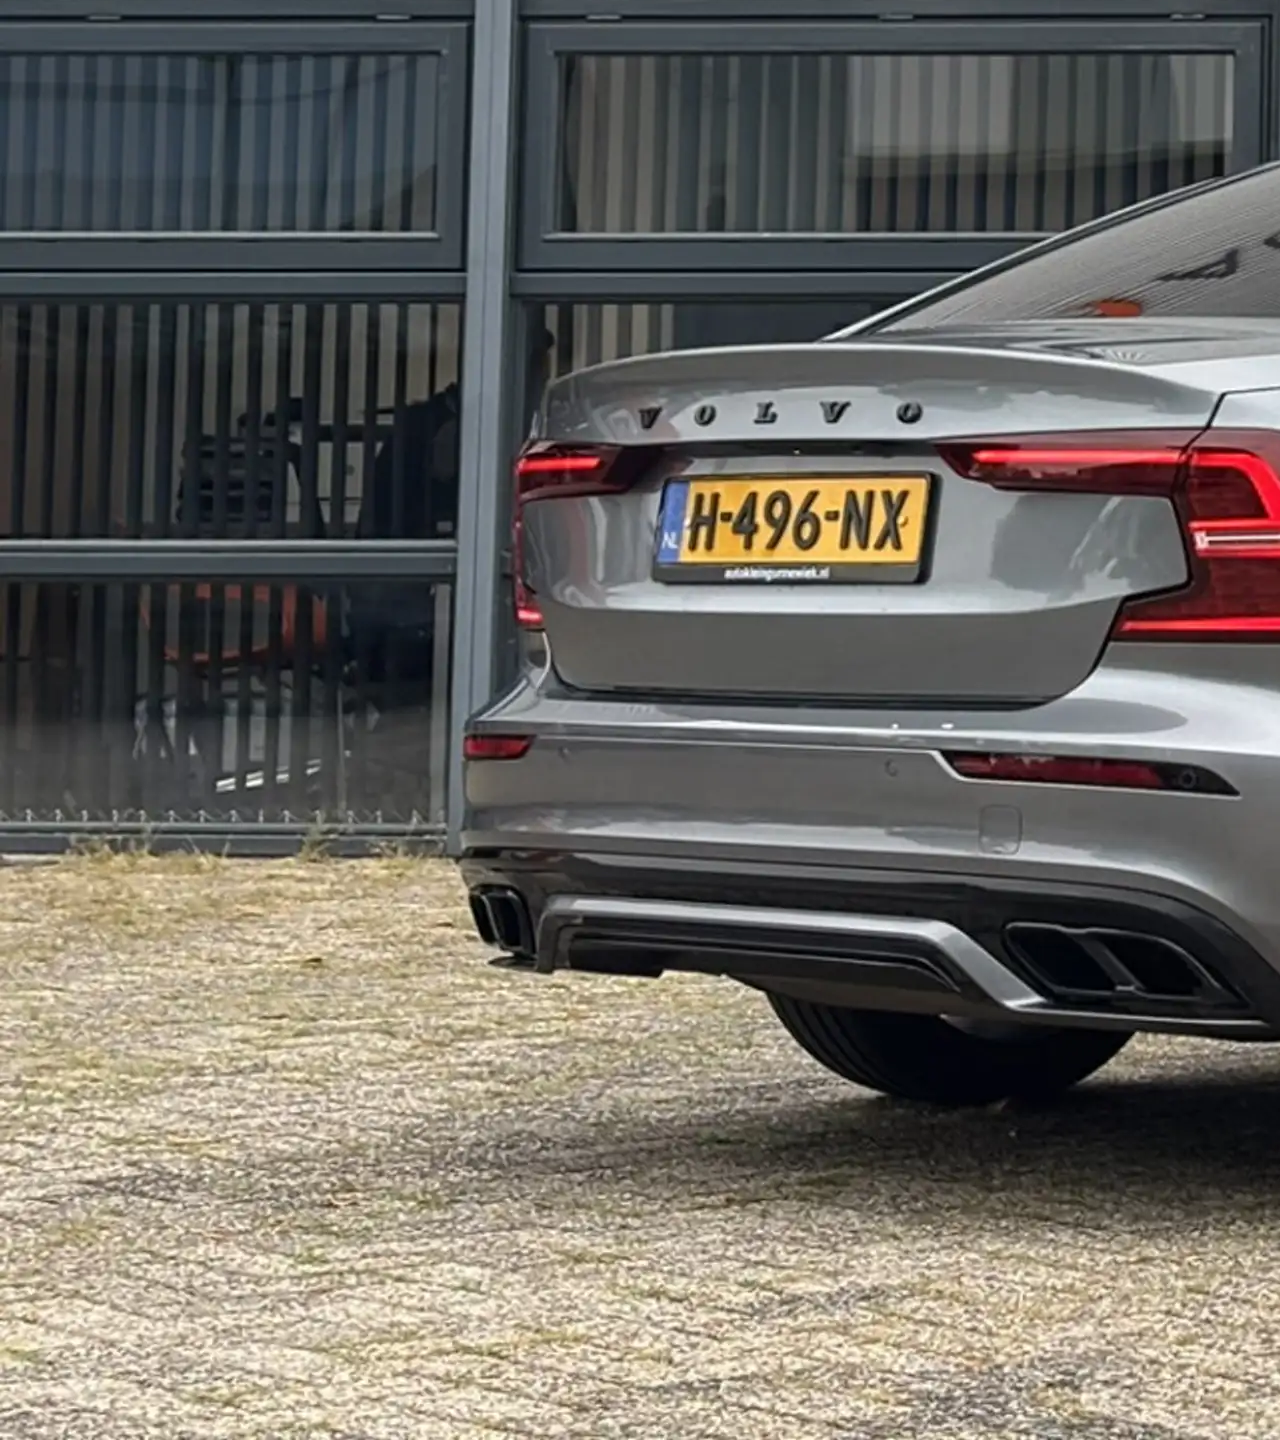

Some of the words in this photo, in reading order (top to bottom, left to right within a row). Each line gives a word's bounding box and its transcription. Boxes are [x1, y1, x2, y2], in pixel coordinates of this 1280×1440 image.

[638, 400, 924, 429] VOLVO
[661, 531, 678, 549] NL
[688, 489, 910, 551] H-496-NX
